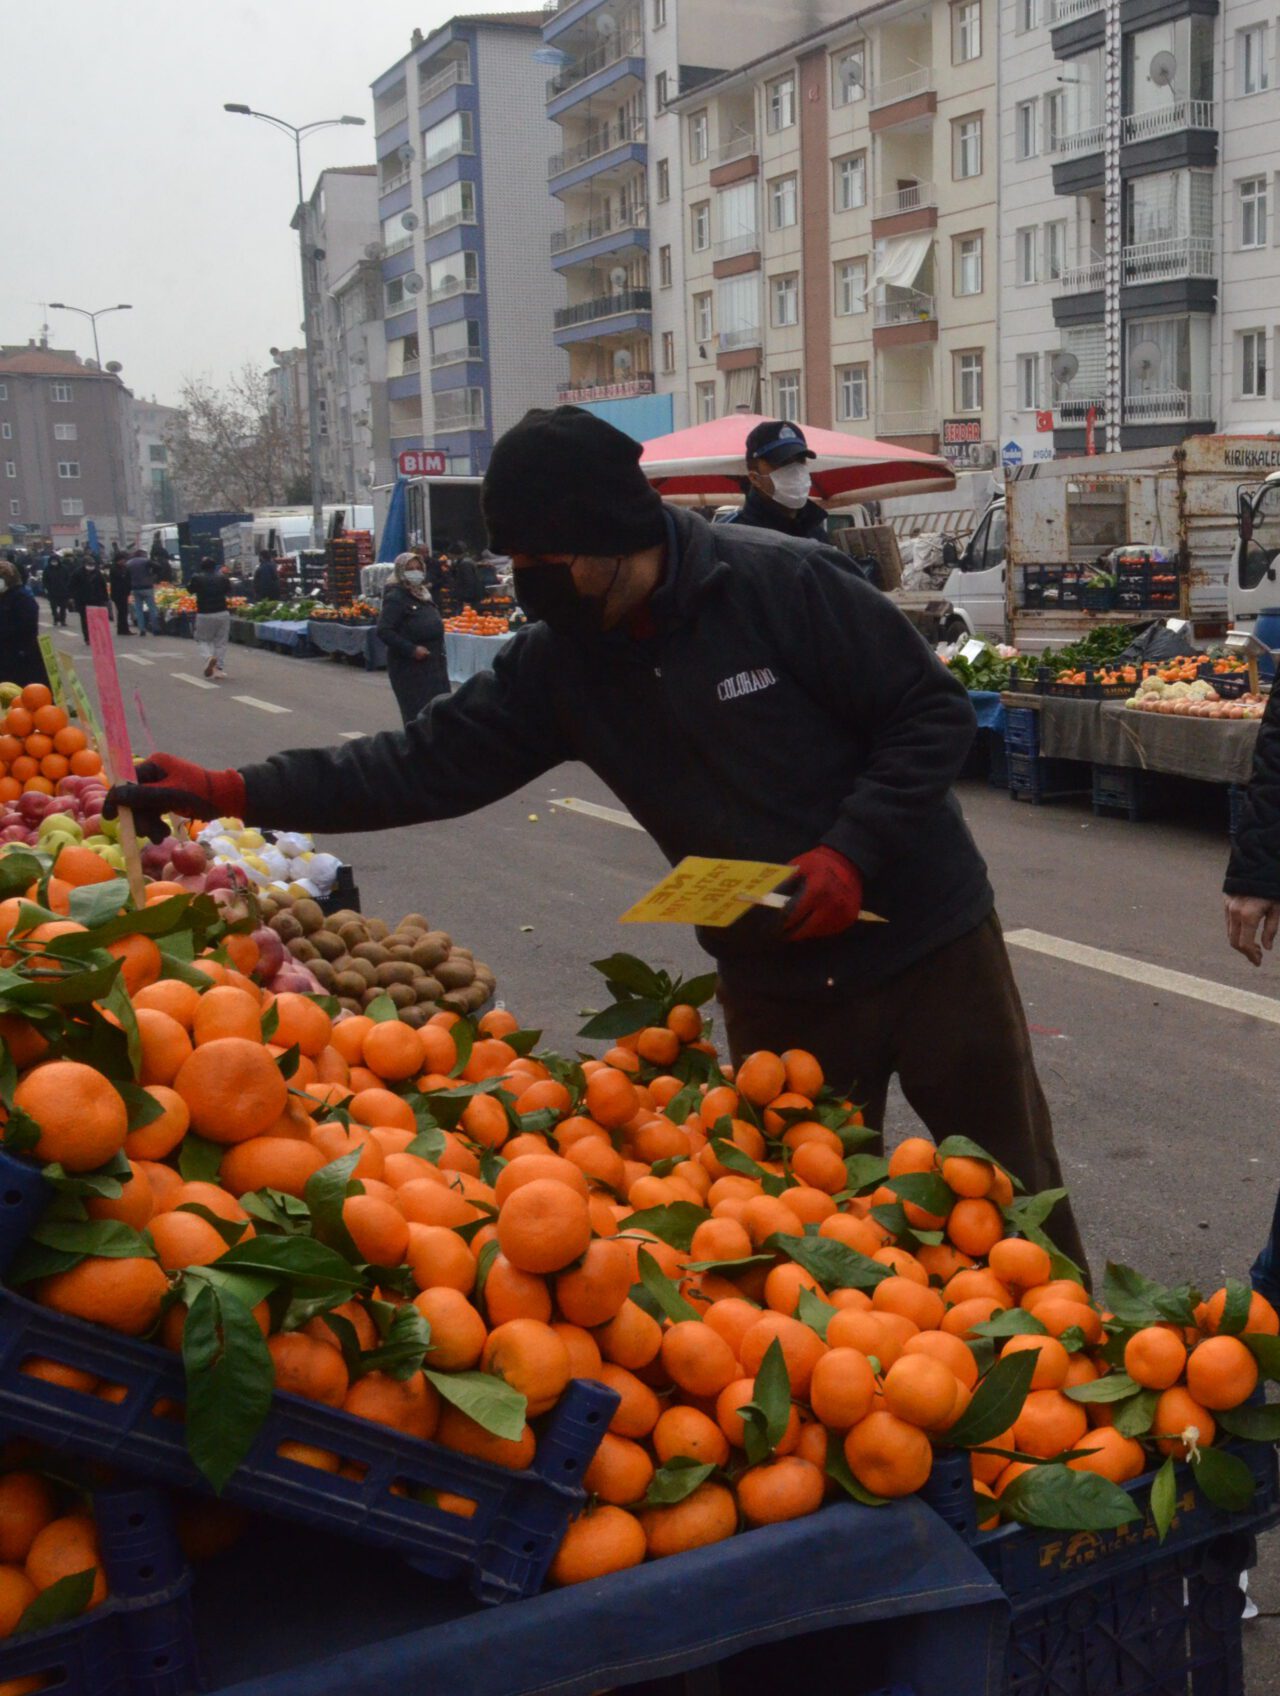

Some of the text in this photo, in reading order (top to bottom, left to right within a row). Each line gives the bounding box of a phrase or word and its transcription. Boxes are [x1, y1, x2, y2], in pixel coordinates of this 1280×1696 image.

[945, 422, 981, 442] SERDAR
[404, 452, 443, 471] BİM
[717, 667, 777, 701] COLORADO
